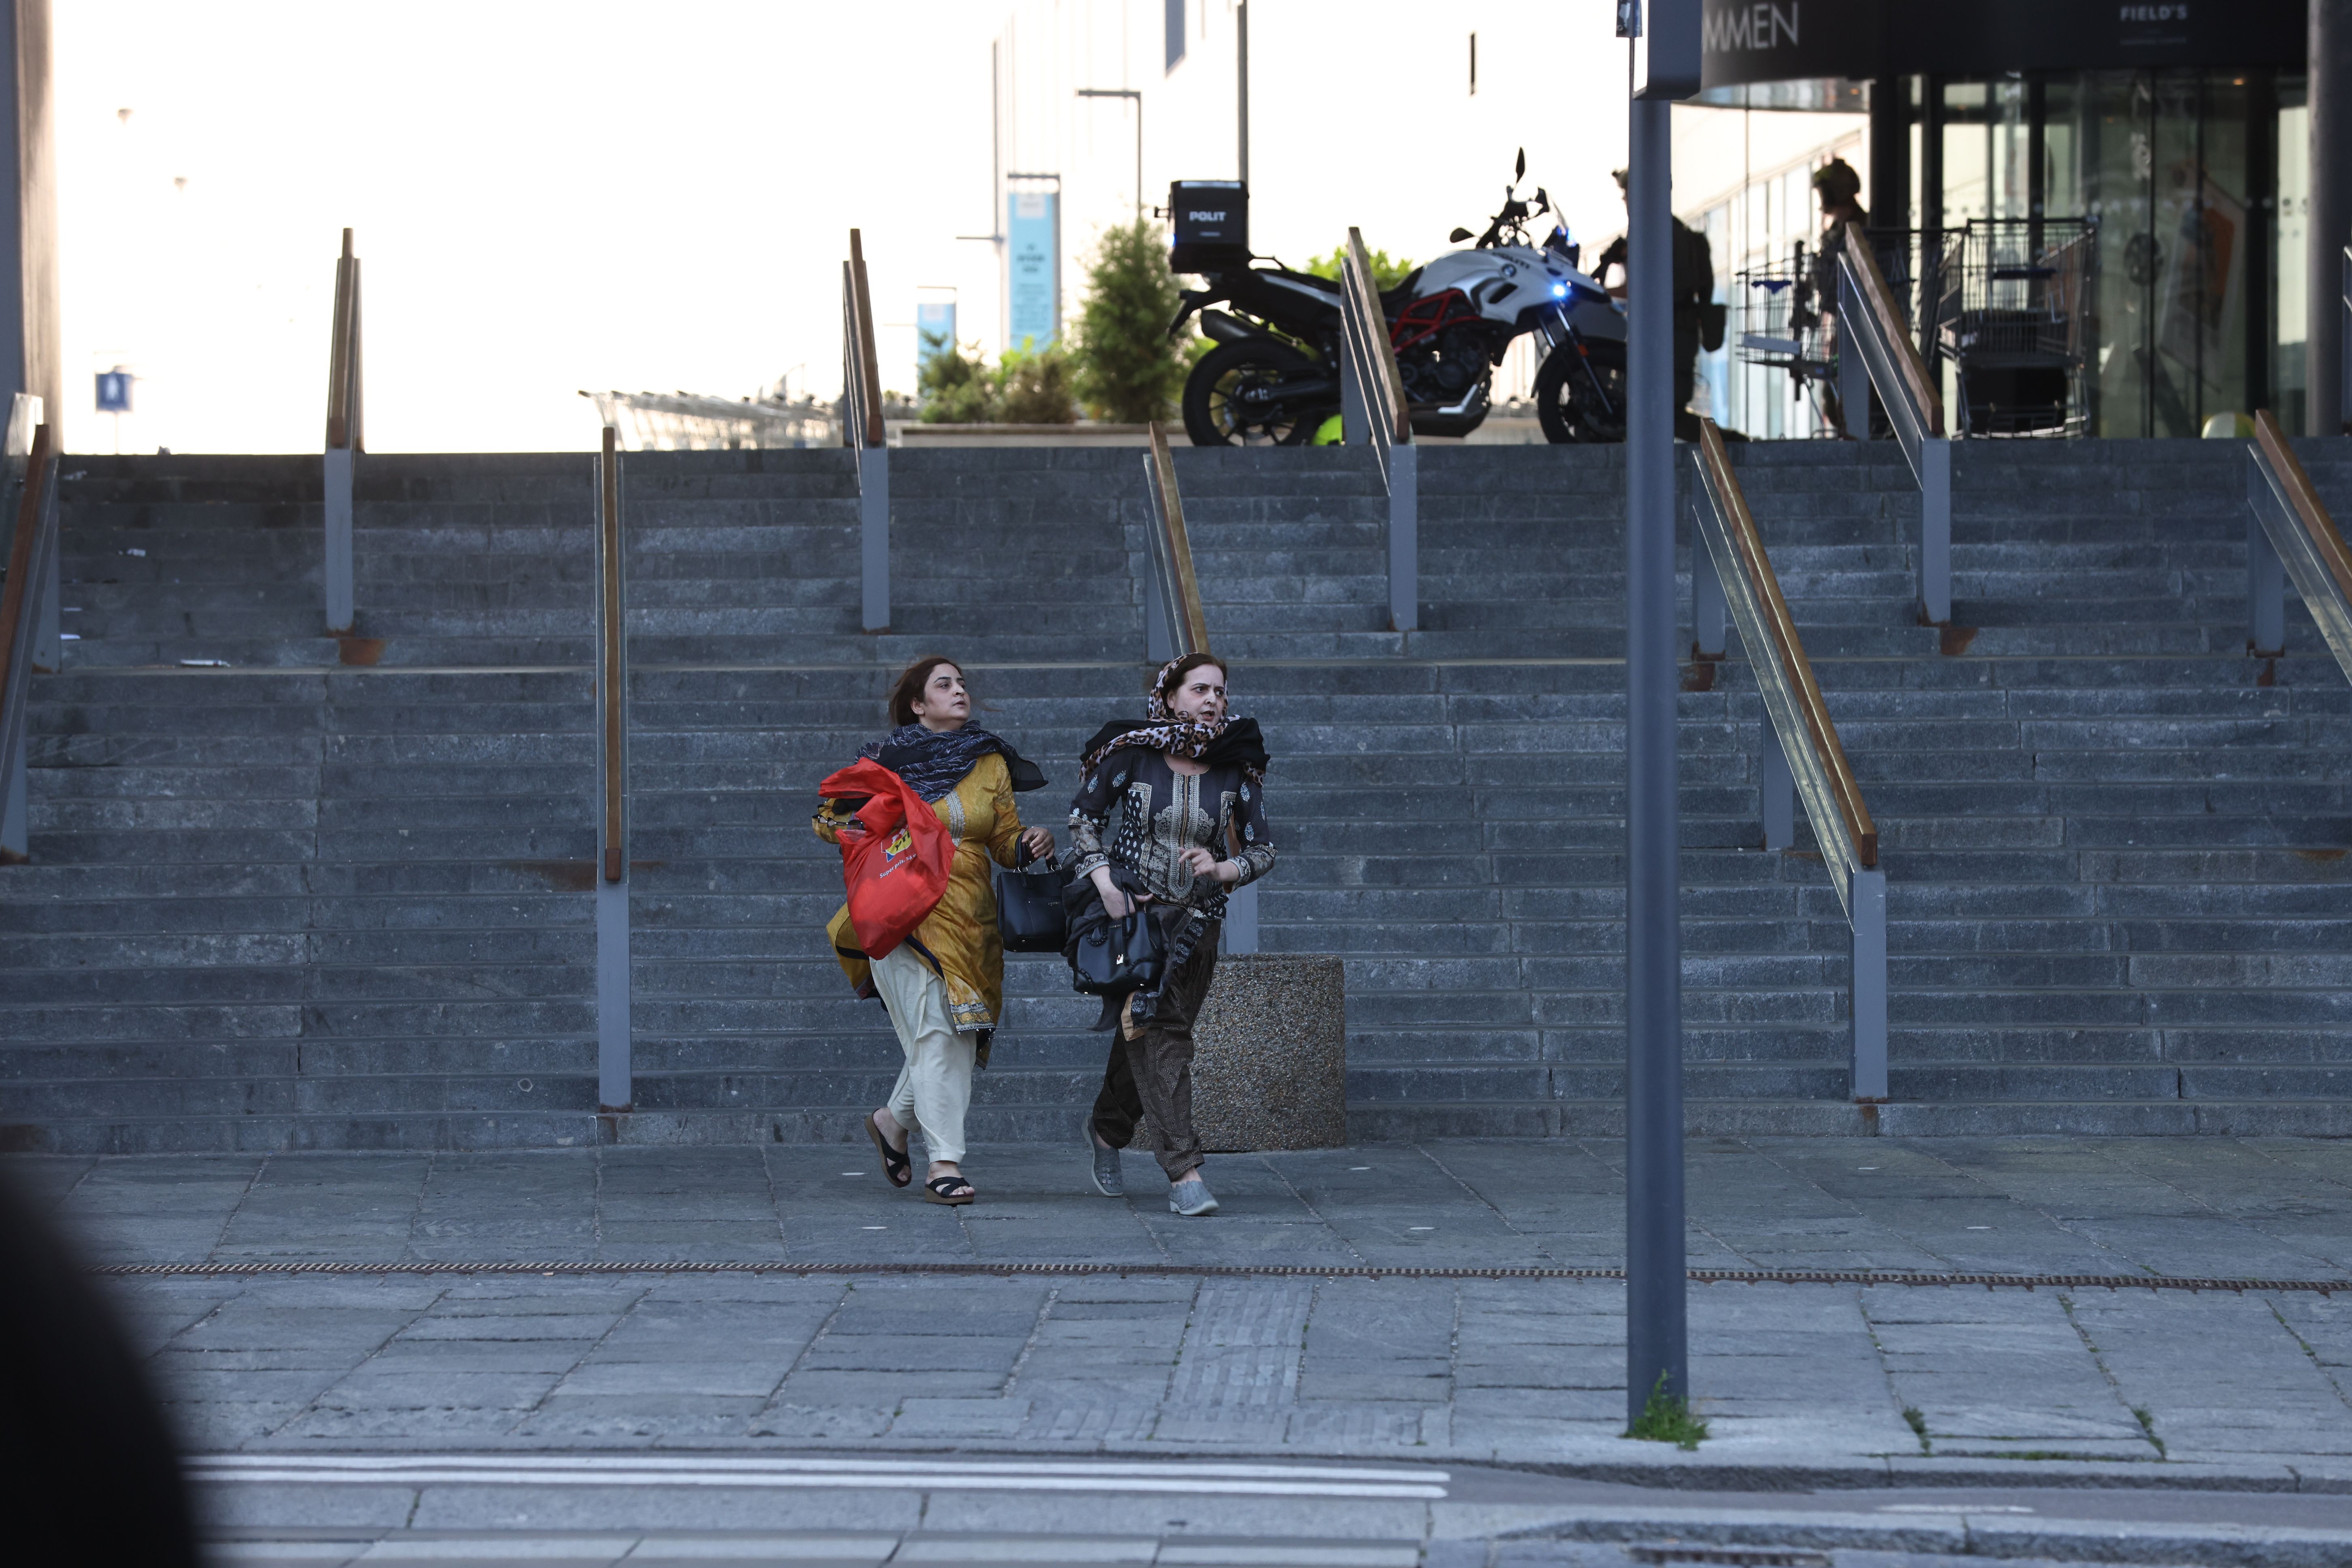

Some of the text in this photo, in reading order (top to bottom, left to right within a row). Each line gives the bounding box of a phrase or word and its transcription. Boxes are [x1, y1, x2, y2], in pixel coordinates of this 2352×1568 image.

[2120, 5, 2188, 20] FIELD'S
[880, 867, 895, 878] Super
[894, 859, 905, 869] pris.
